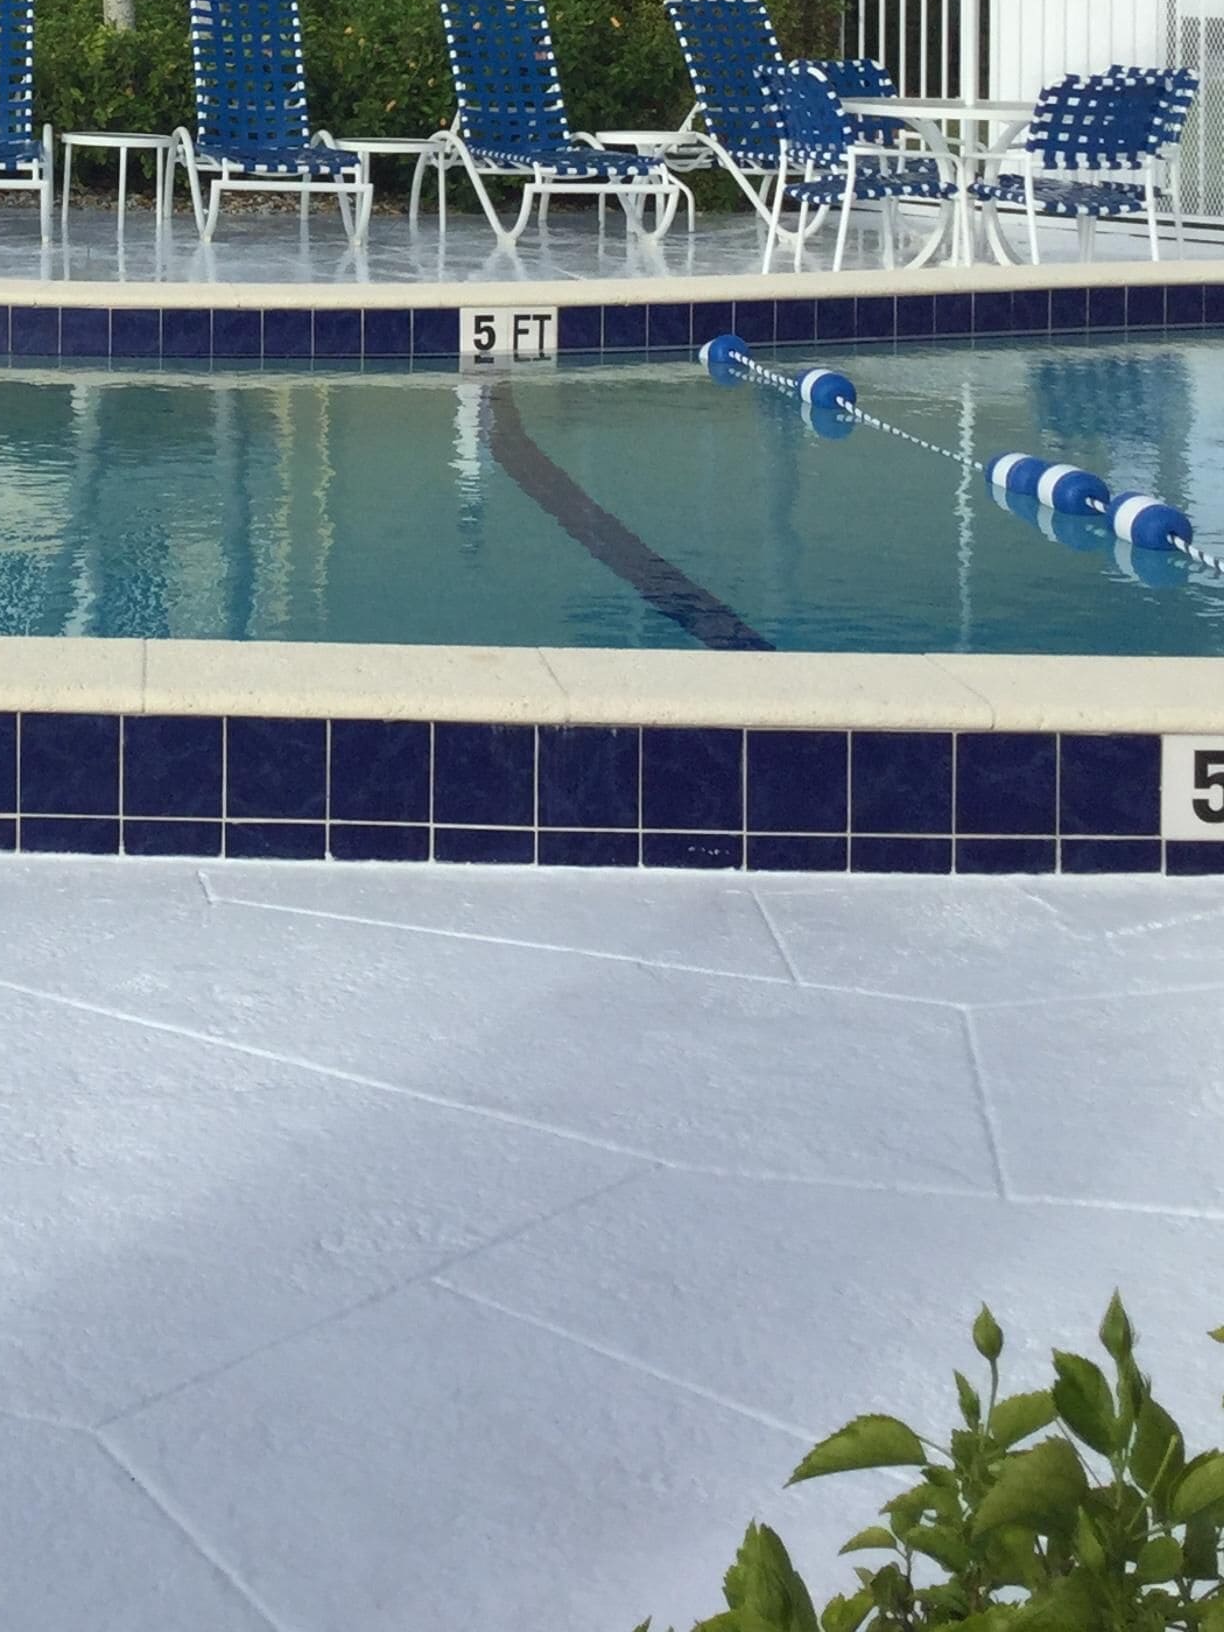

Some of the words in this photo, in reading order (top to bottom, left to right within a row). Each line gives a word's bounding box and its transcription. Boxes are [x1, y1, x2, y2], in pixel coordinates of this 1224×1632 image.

[473, 315, 496, 351] 5
[513, 315, 552, 352] FT
[1192, 750, 1224, 824] 5
